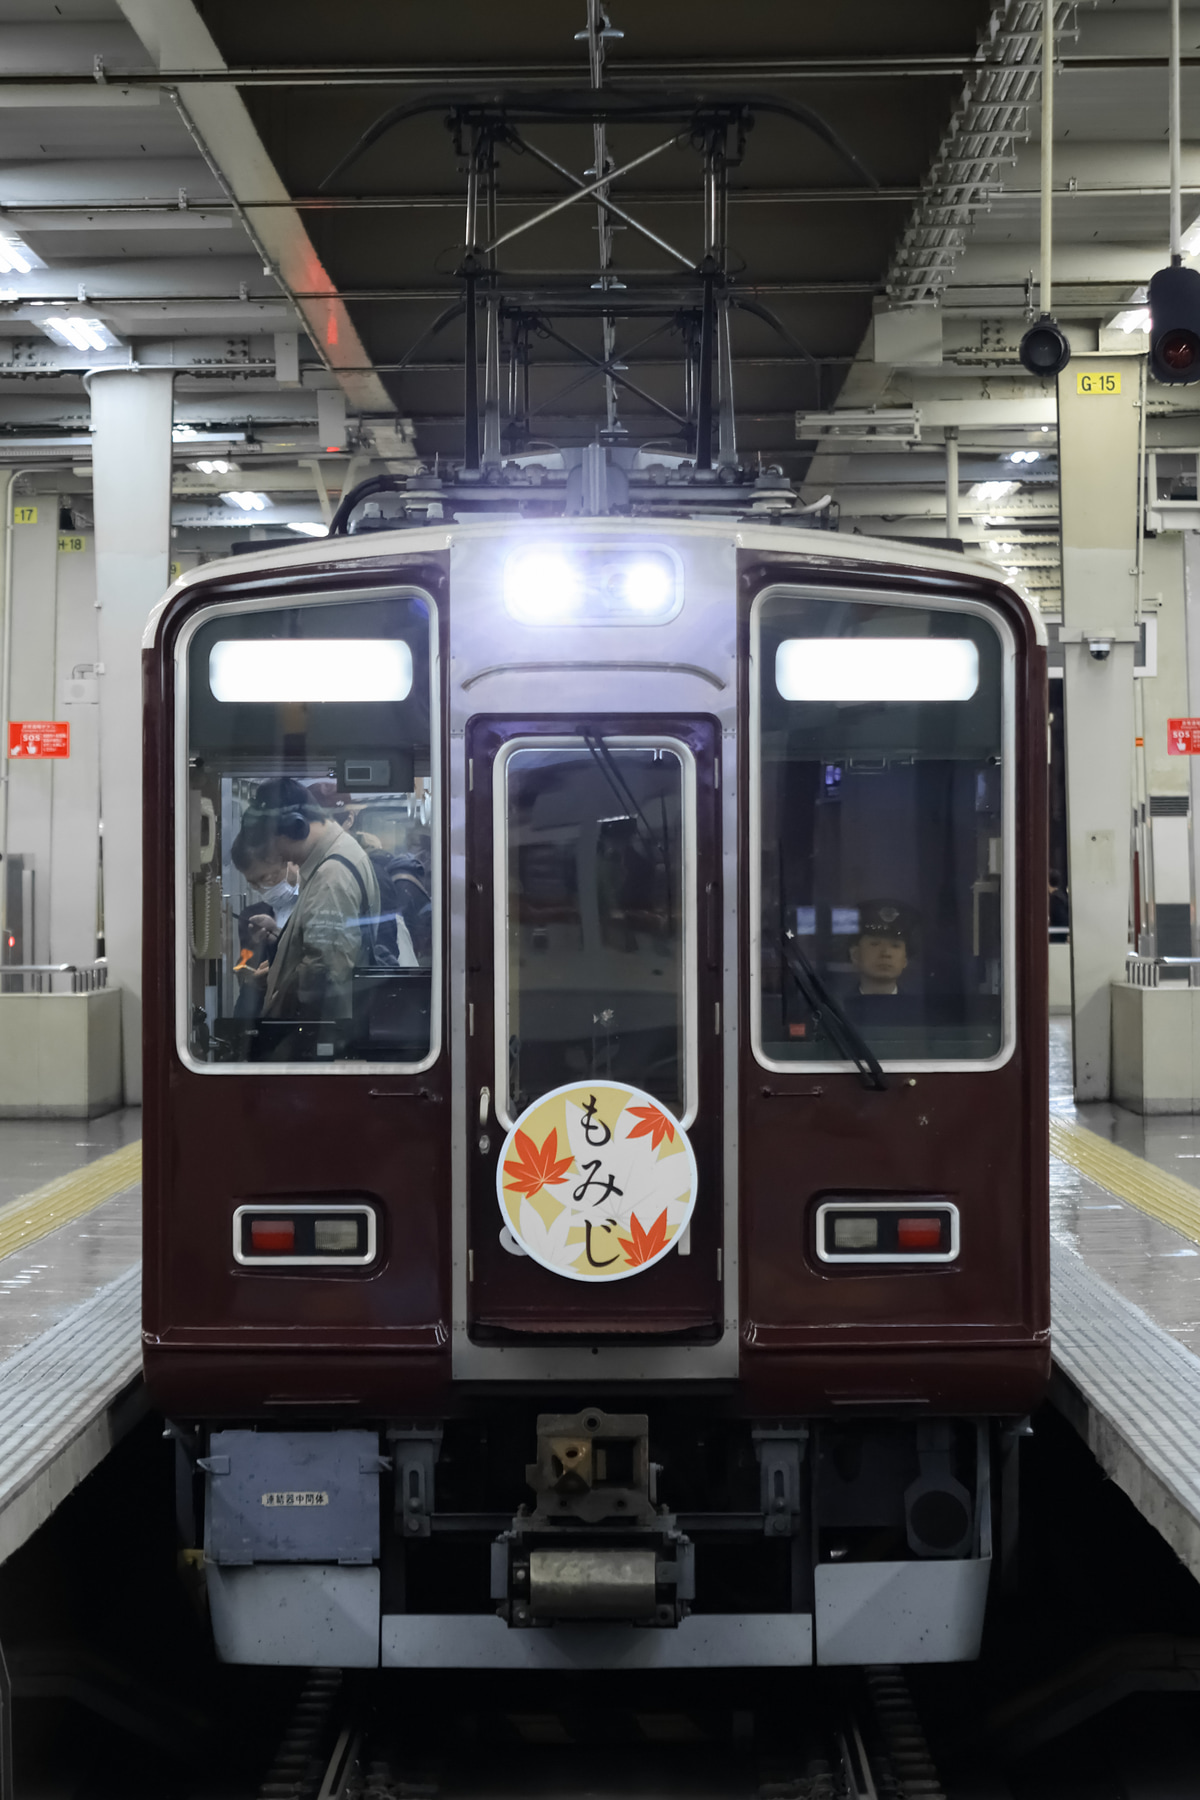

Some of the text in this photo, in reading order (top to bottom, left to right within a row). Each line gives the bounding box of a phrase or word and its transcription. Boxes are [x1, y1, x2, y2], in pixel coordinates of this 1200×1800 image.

[1081, 375, 1115, 391] G-15
[14, 509, 34, 521] -17
[22, 733, 41, 742] SOS
[1172, 730, 1191, 739] SOS
[573, 1094, 624, 1268] もみじ
